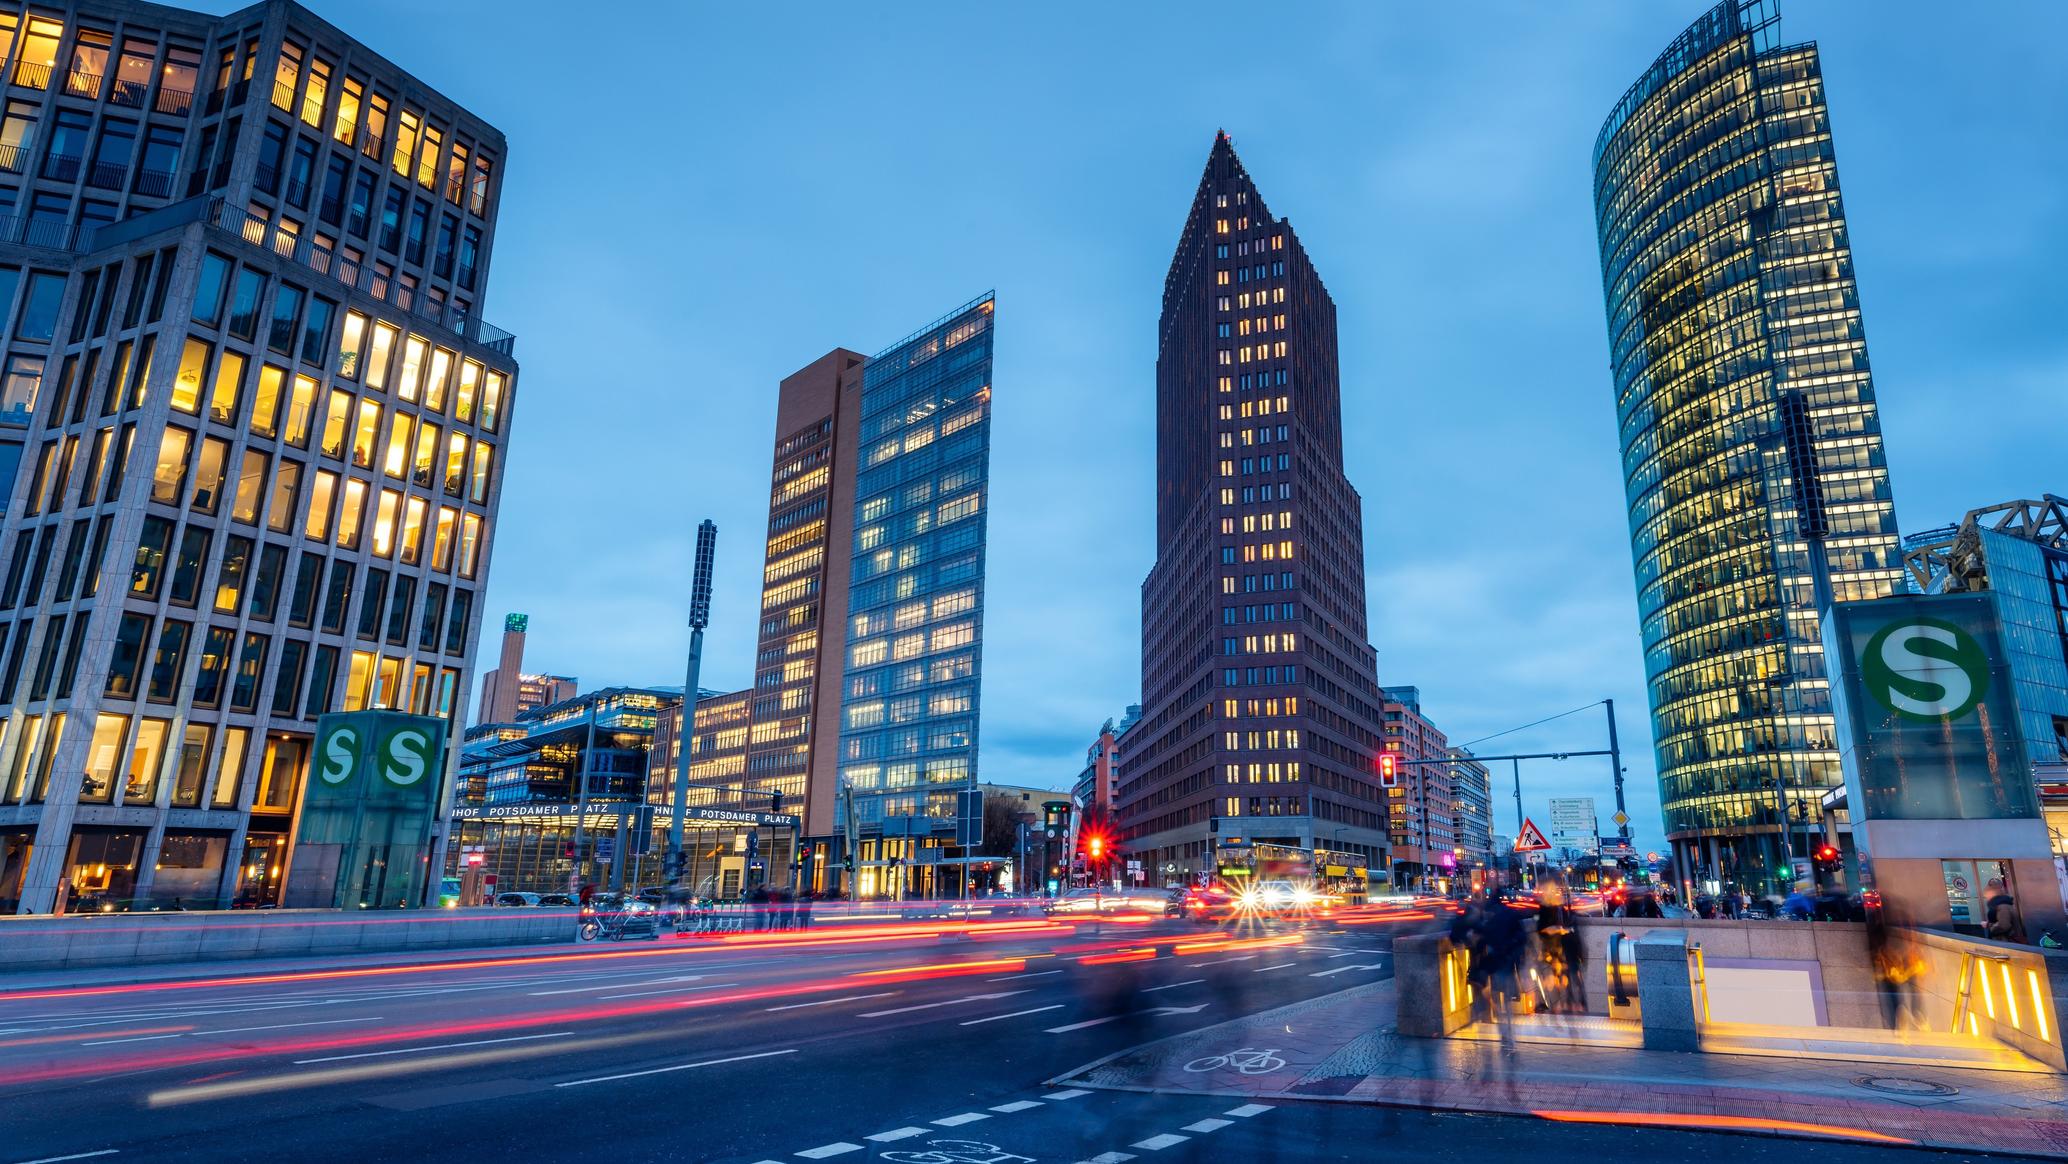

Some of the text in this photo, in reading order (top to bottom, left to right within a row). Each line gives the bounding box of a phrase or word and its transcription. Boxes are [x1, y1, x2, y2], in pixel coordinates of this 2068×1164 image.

[1881, 625, 1972, 716] S
[323, 729, 356, 784] S
[385, 730, 427, 785] S
[489, 805, 560, 816] POTSDAMER
[570, 803, 609, 814] PATZ
[700, 809, 757, 822] POTSDAMER
[764, 814, 792, 824] PLATZ
